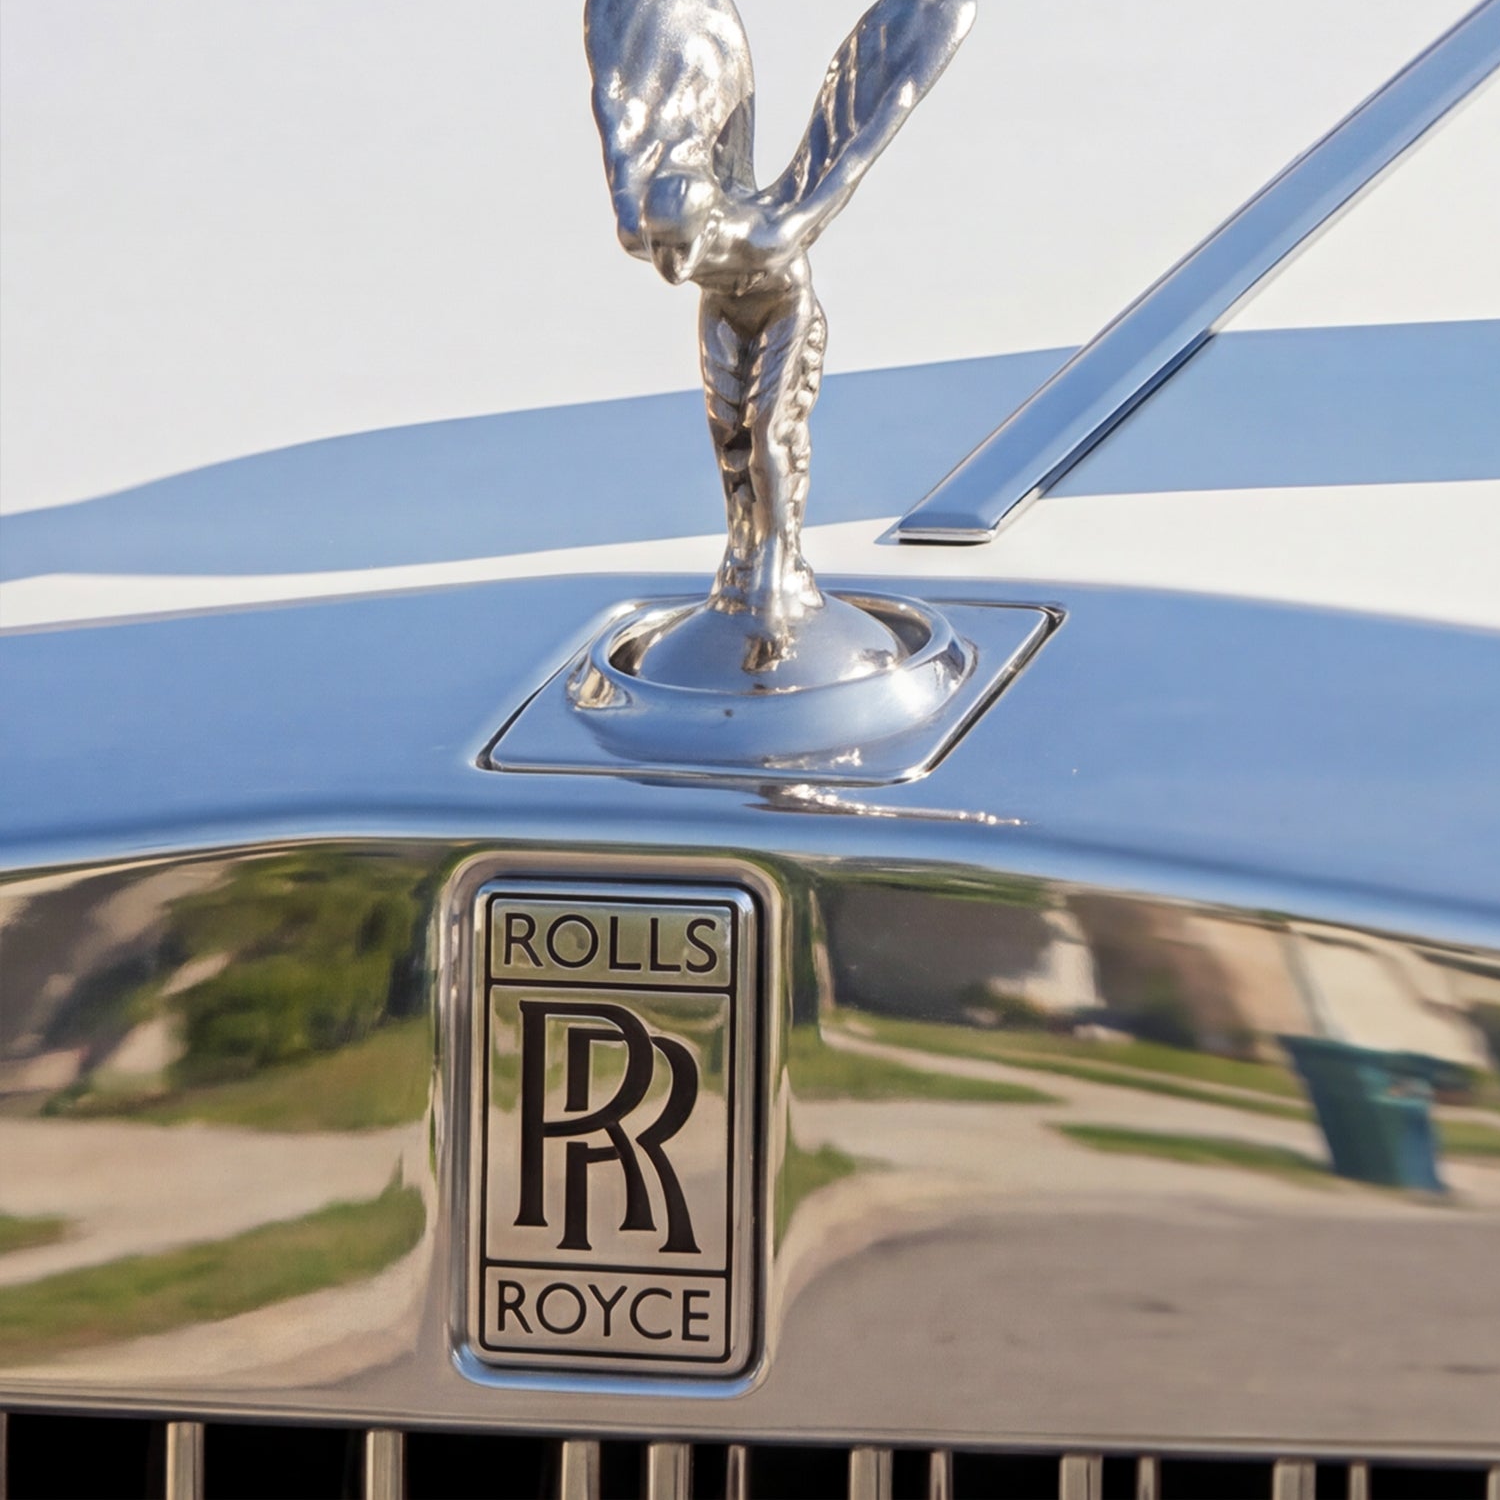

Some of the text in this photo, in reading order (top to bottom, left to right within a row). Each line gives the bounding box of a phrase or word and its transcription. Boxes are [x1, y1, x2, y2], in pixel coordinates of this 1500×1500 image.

[503, 912, 718, 973] ROLLS
[513, 999, 702, 1254] RR
[497, 1279, 711, 1342] ROYCE
